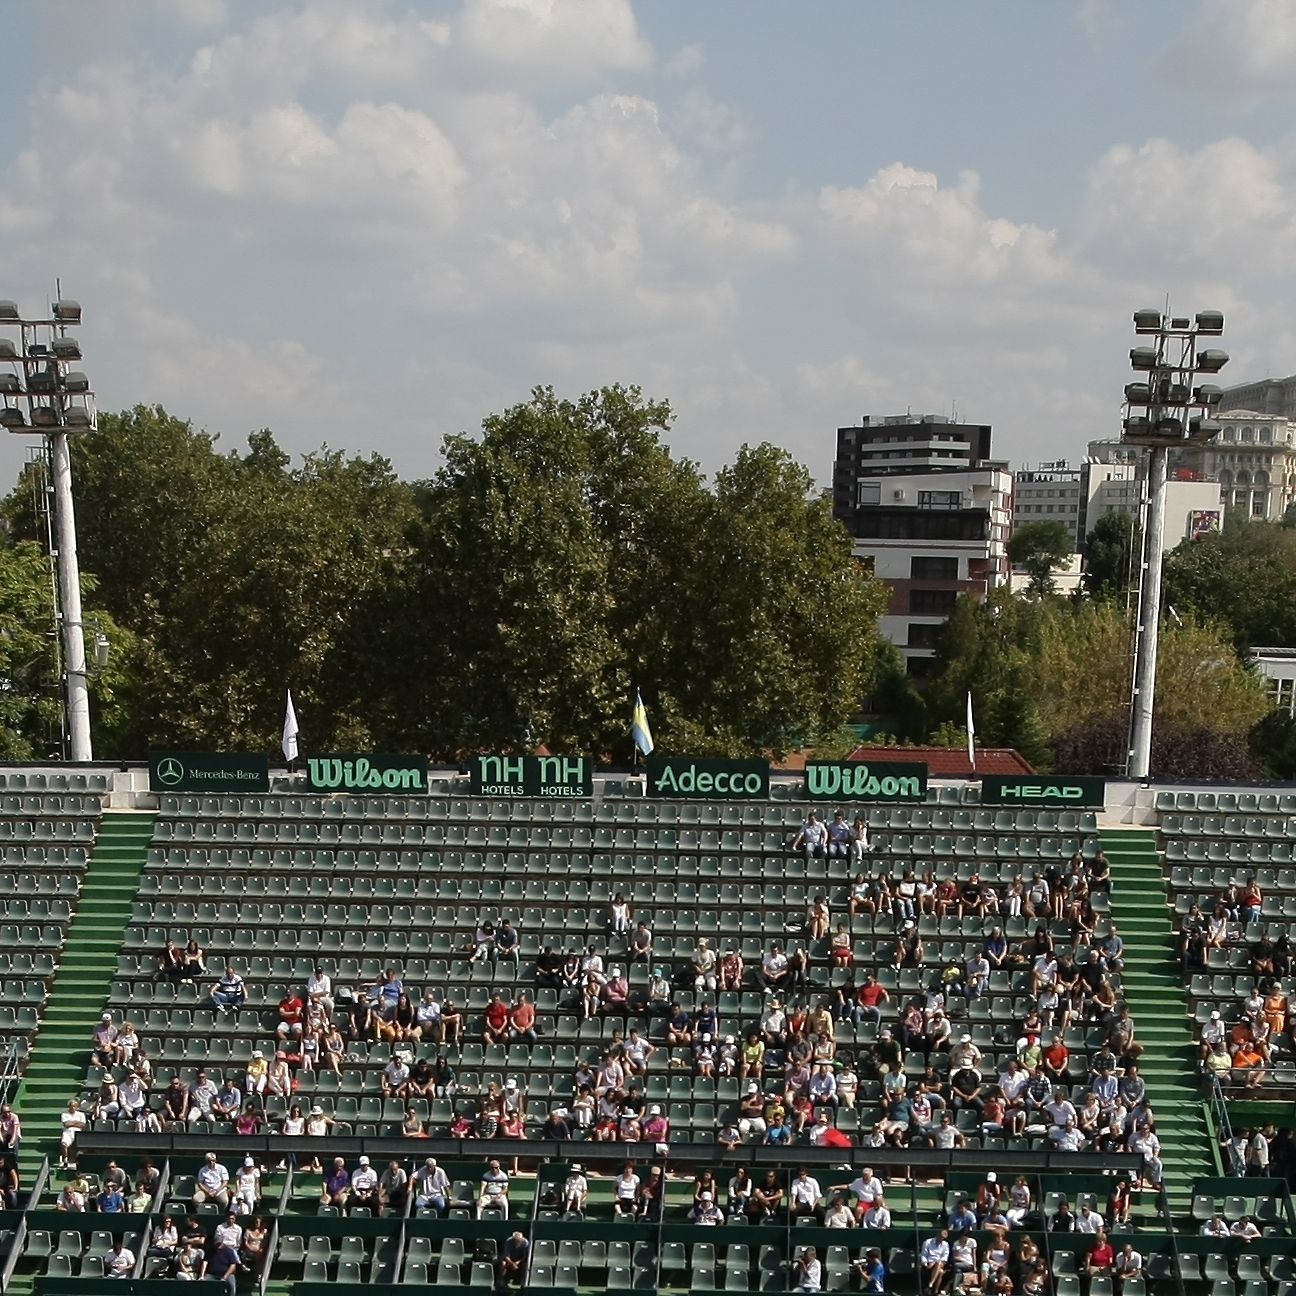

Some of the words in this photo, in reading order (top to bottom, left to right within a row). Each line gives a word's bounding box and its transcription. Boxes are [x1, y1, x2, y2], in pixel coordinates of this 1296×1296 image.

[189, 767, 260, 781] Mercedes-Benz
[308, 757, 424, 790] Wilson
[655, 765, 761, 794] Adecco
[806, 765, 922, 797] Wilson
[481, 785, 524, 795] HOTELS
[541, 786, 584, 797] HOTELS
[1001, 785, 1083, 799] HEAD
